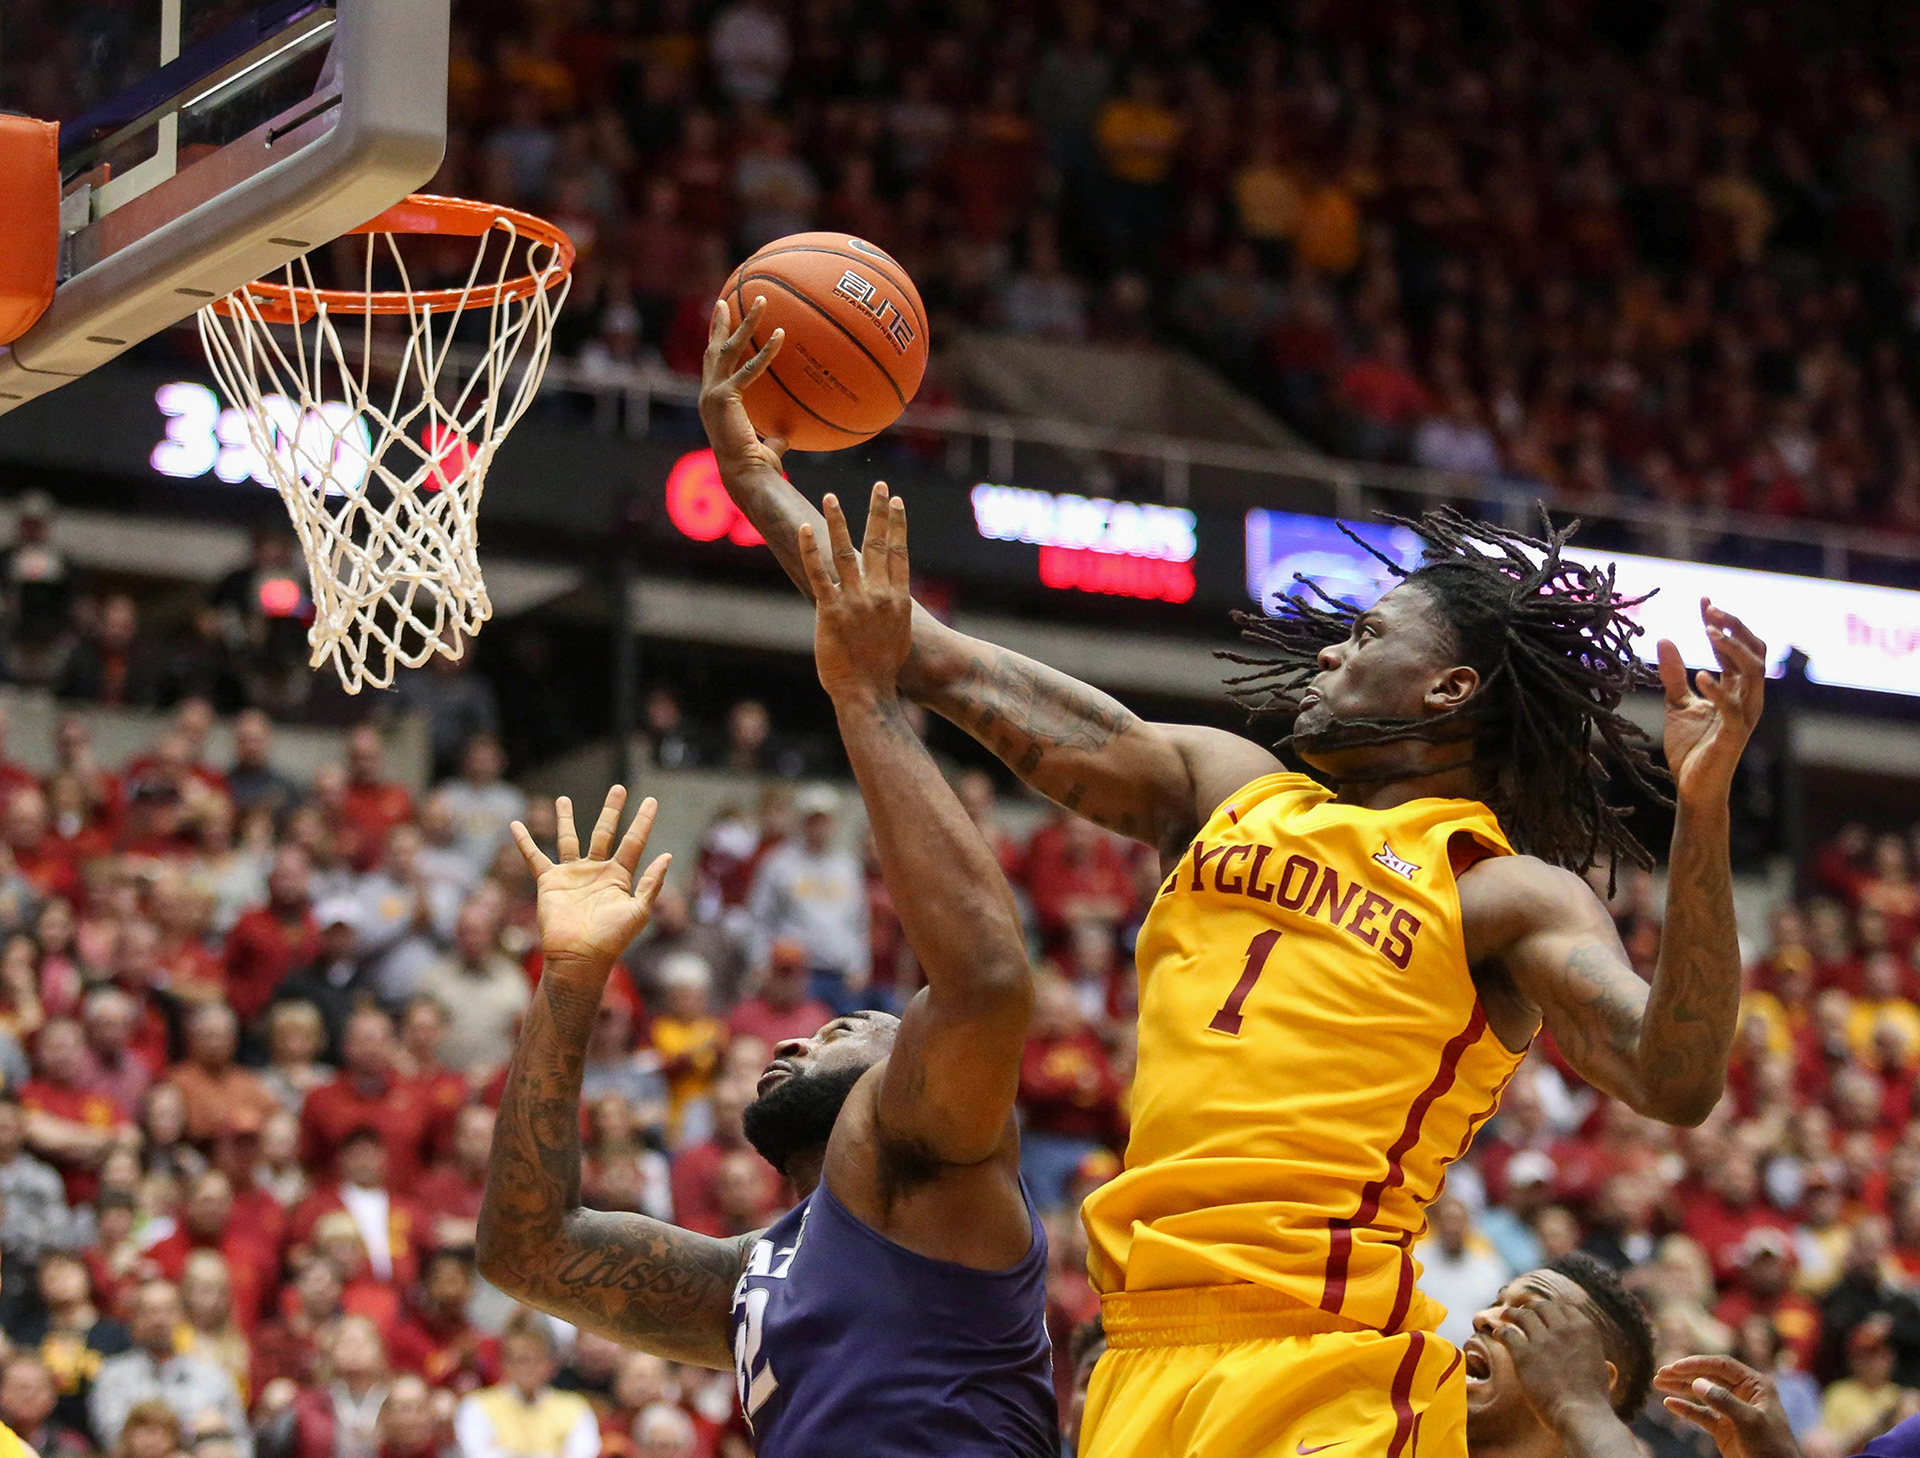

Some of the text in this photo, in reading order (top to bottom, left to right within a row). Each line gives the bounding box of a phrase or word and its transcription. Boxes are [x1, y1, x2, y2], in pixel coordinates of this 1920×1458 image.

[832, 289, 902, 356] CHAMPIONSHIP
[836, 270, 915, 351] ELITE
[1204, 928, 1283, 1038] 1
